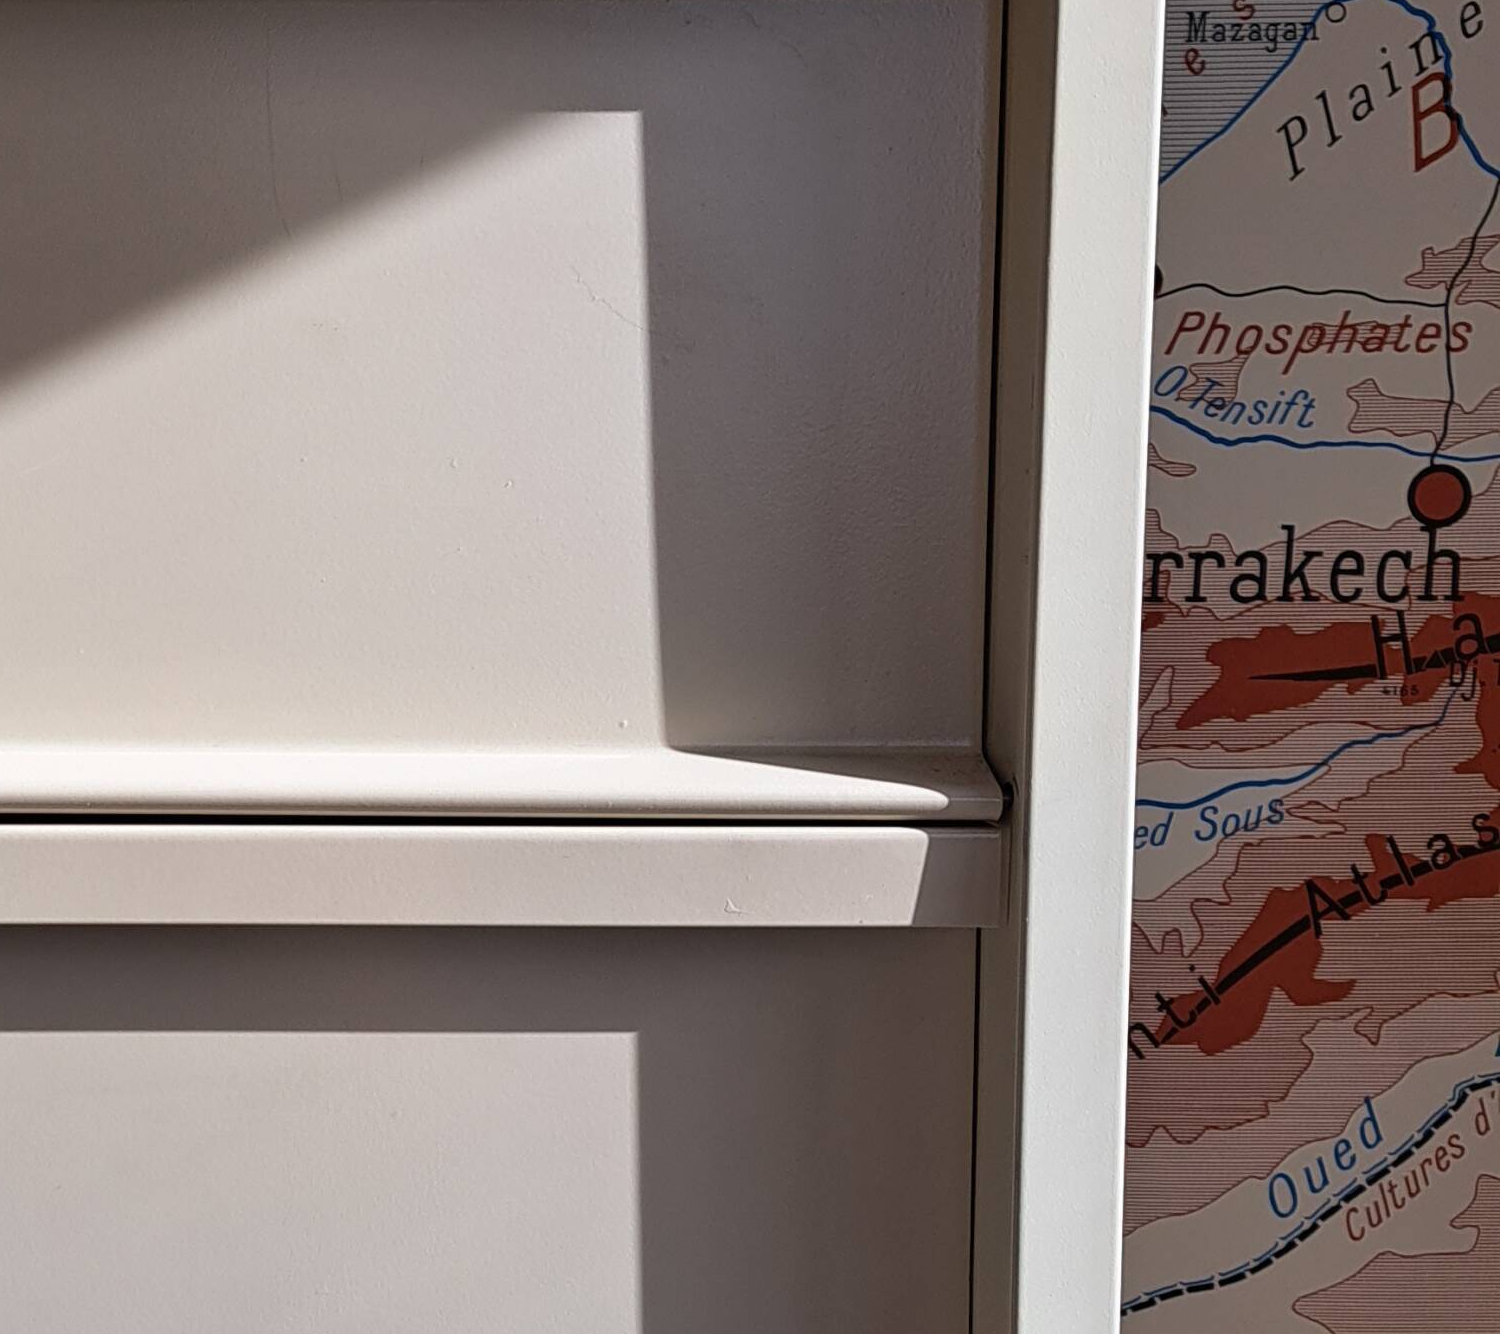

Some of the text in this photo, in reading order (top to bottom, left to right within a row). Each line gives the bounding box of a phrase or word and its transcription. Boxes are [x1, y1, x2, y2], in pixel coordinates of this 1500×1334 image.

[1185, 11, 1320, 53] Mazagan
[1276, 0, 1484, 181] Plaine
[1164, 309, 1473, 375] Phosphates
[1142, 524, 1465, 603] rrakech
[1194, 798, 1285, 842] Sous
[1305, 813, 1500, 939] Atlas
[1267, 1096, 1384, 1219] Oued
[1345, 1133, 1466, 1241] Cultures
